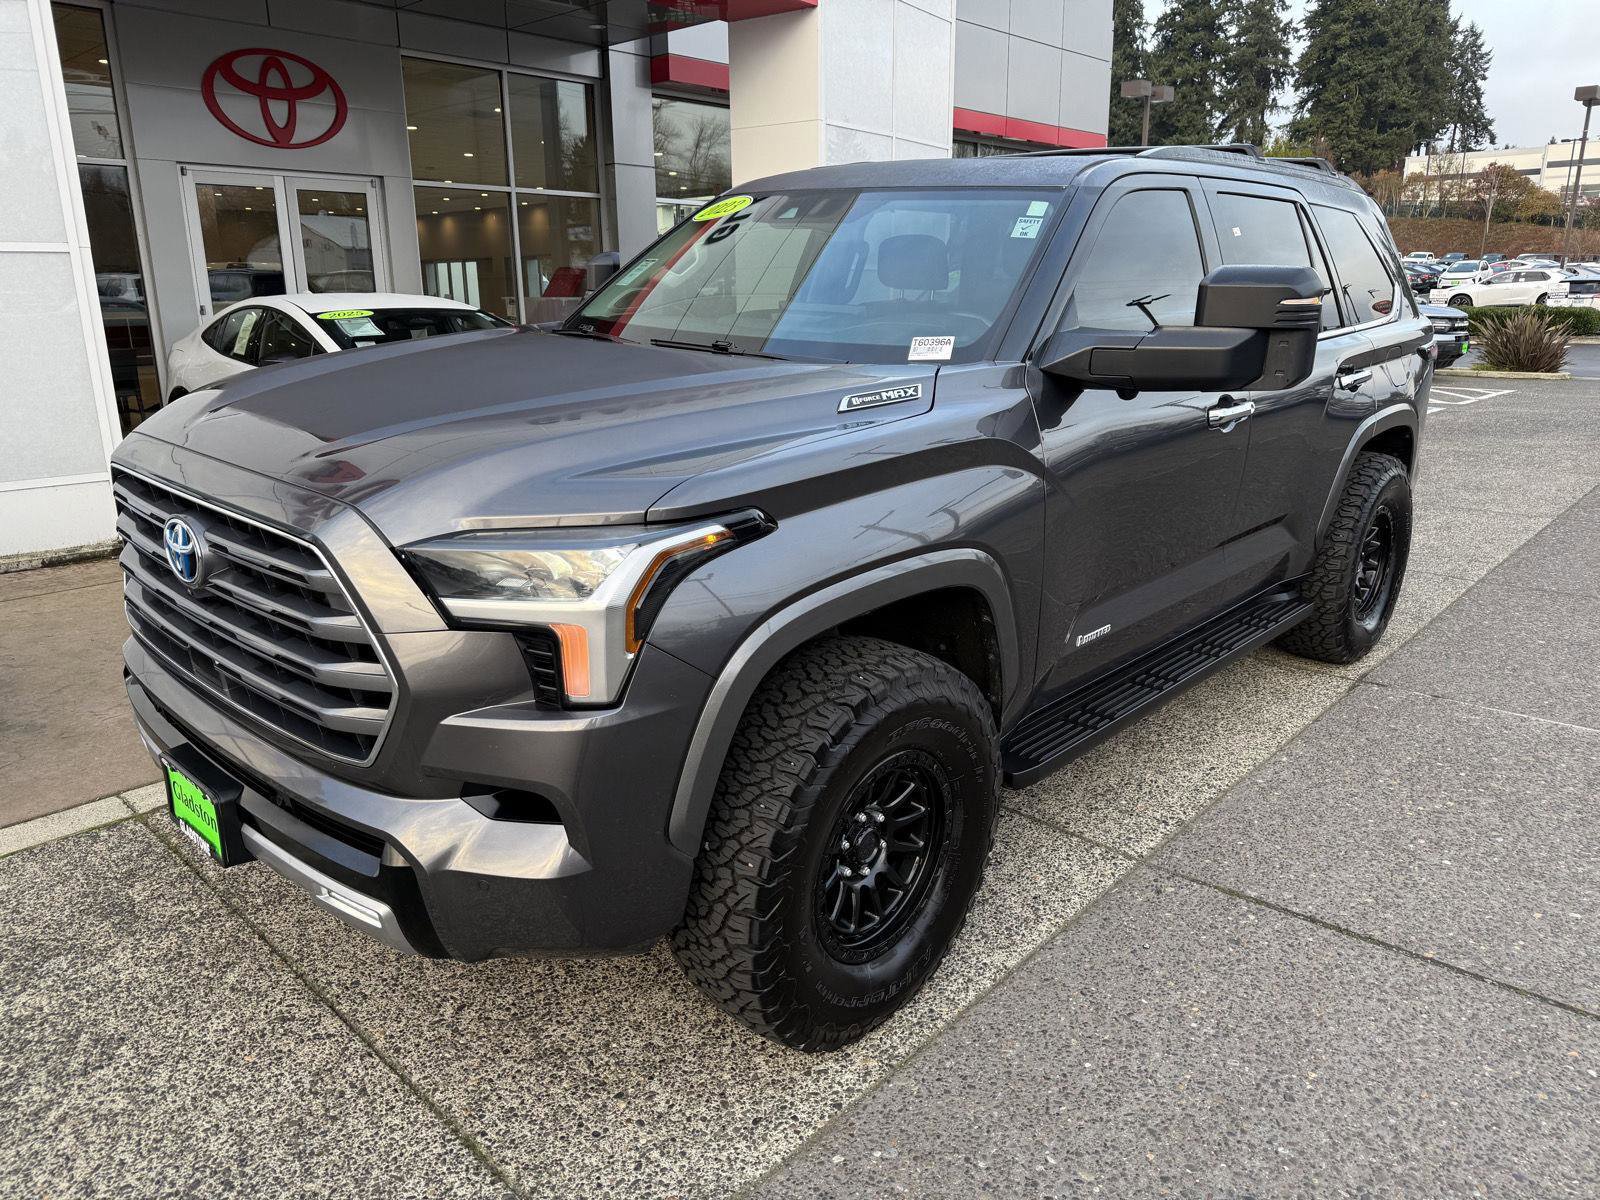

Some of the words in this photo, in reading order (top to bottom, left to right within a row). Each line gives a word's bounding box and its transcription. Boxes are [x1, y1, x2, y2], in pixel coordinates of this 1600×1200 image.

[328, 311, 364, 319] 2025
[912, 338, 952, 347] T60396A
[881, 386, 918, 400] MAX
